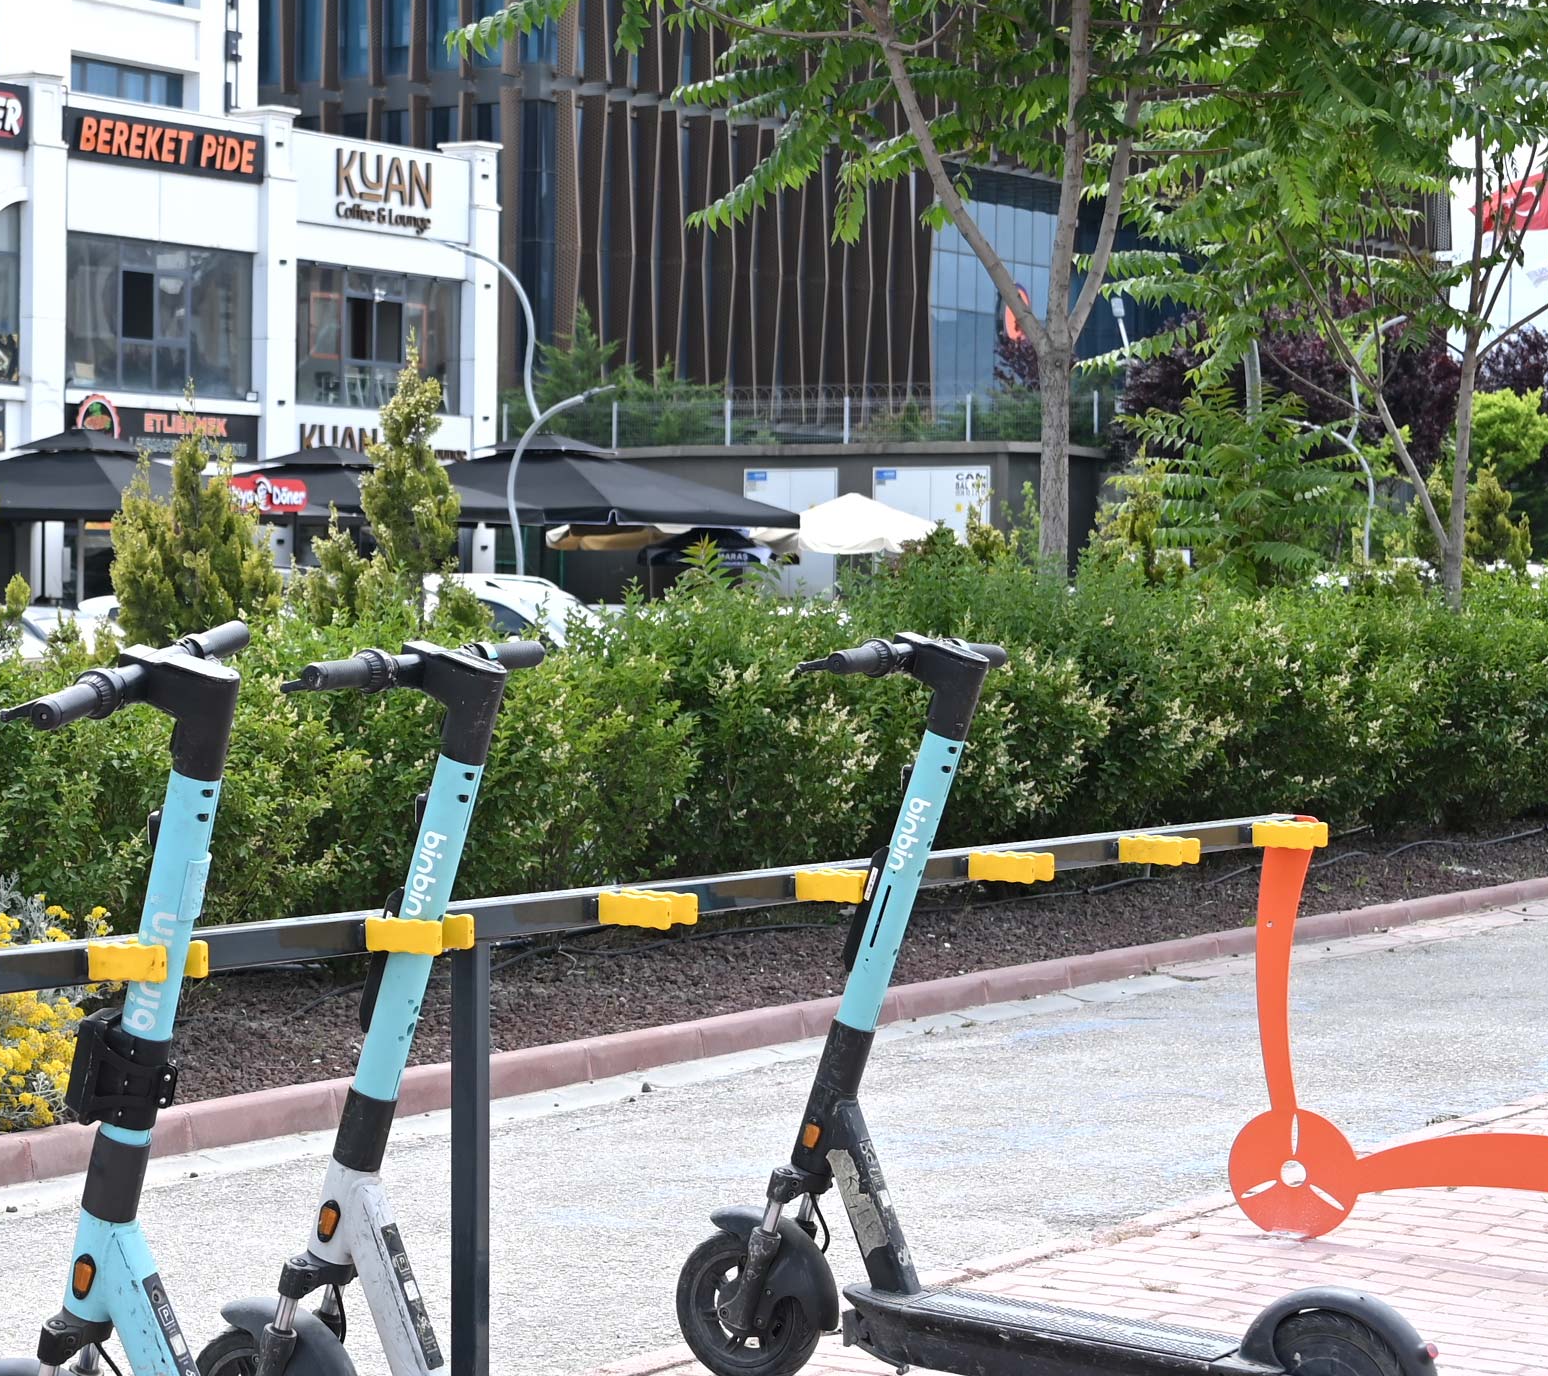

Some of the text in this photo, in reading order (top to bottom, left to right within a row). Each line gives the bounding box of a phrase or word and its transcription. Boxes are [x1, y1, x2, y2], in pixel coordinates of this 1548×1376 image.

[79, 116, 194, 165] BEREKET
[336, 201, 376, 223] Coffee
[388, 208, 432, 235] Lounge
[271, 485, 306, 506] Döner
[888, 796, 931, 871] binbin
[405, 830, 447, 916] binbin
